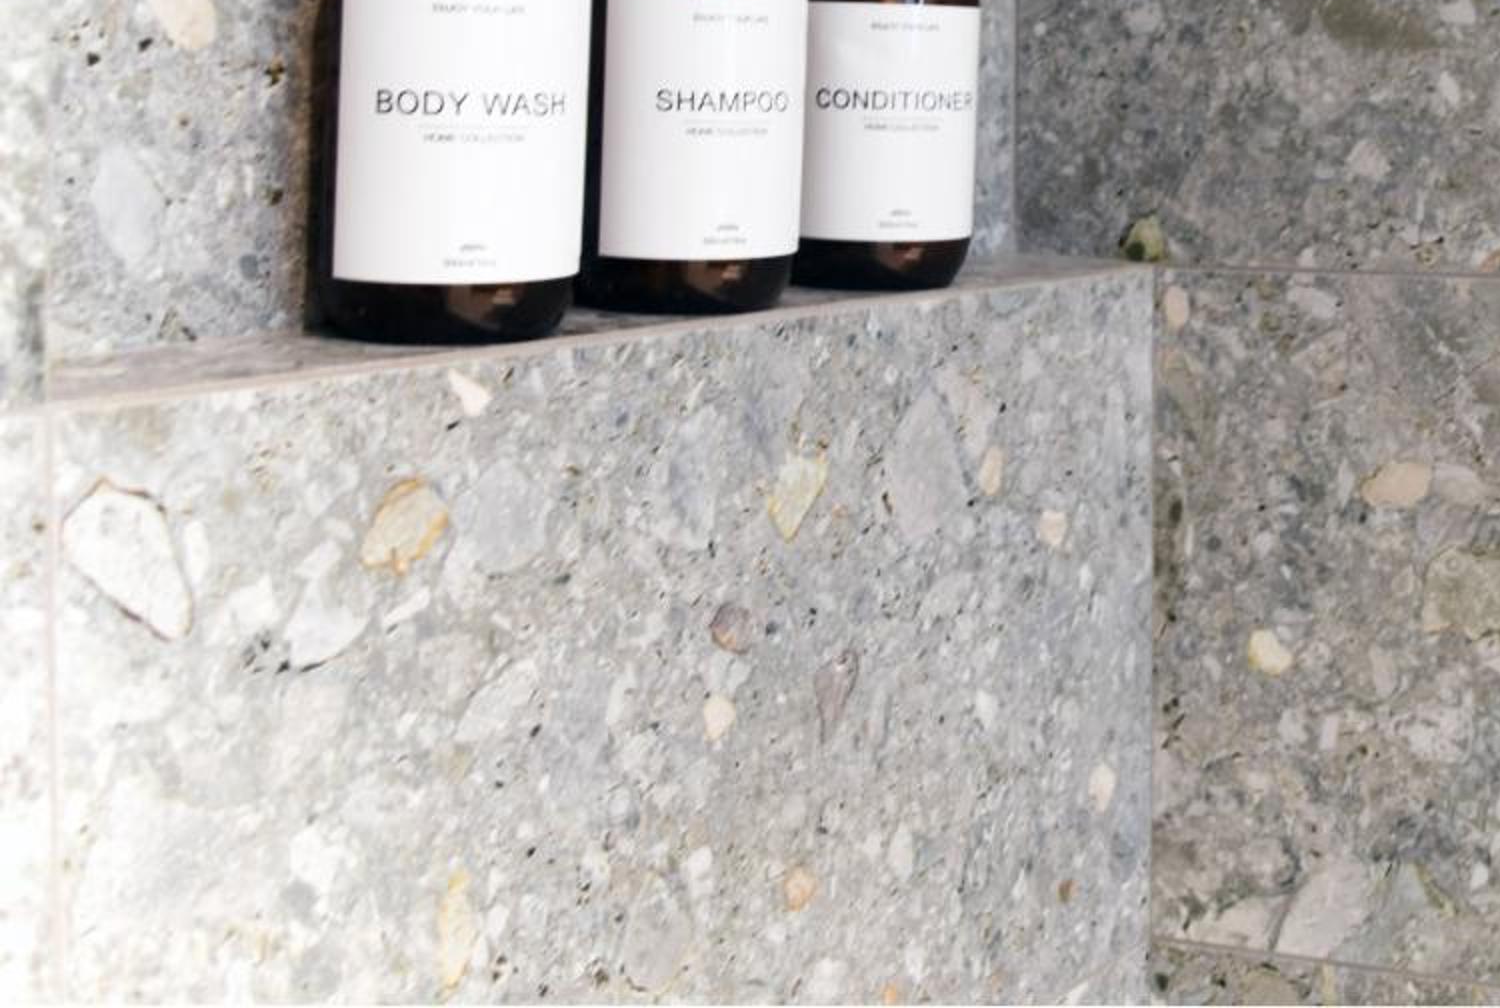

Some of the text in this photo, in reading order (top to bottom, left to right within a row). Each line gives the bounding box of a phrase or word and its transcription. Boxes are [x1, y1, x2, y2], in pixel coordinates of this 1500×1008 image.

[374, 88, 567, 117] BODY WASH
[655, 88, 790, 113] SHAMPOO
[815, 86, 974, 112] CONDITIONER
